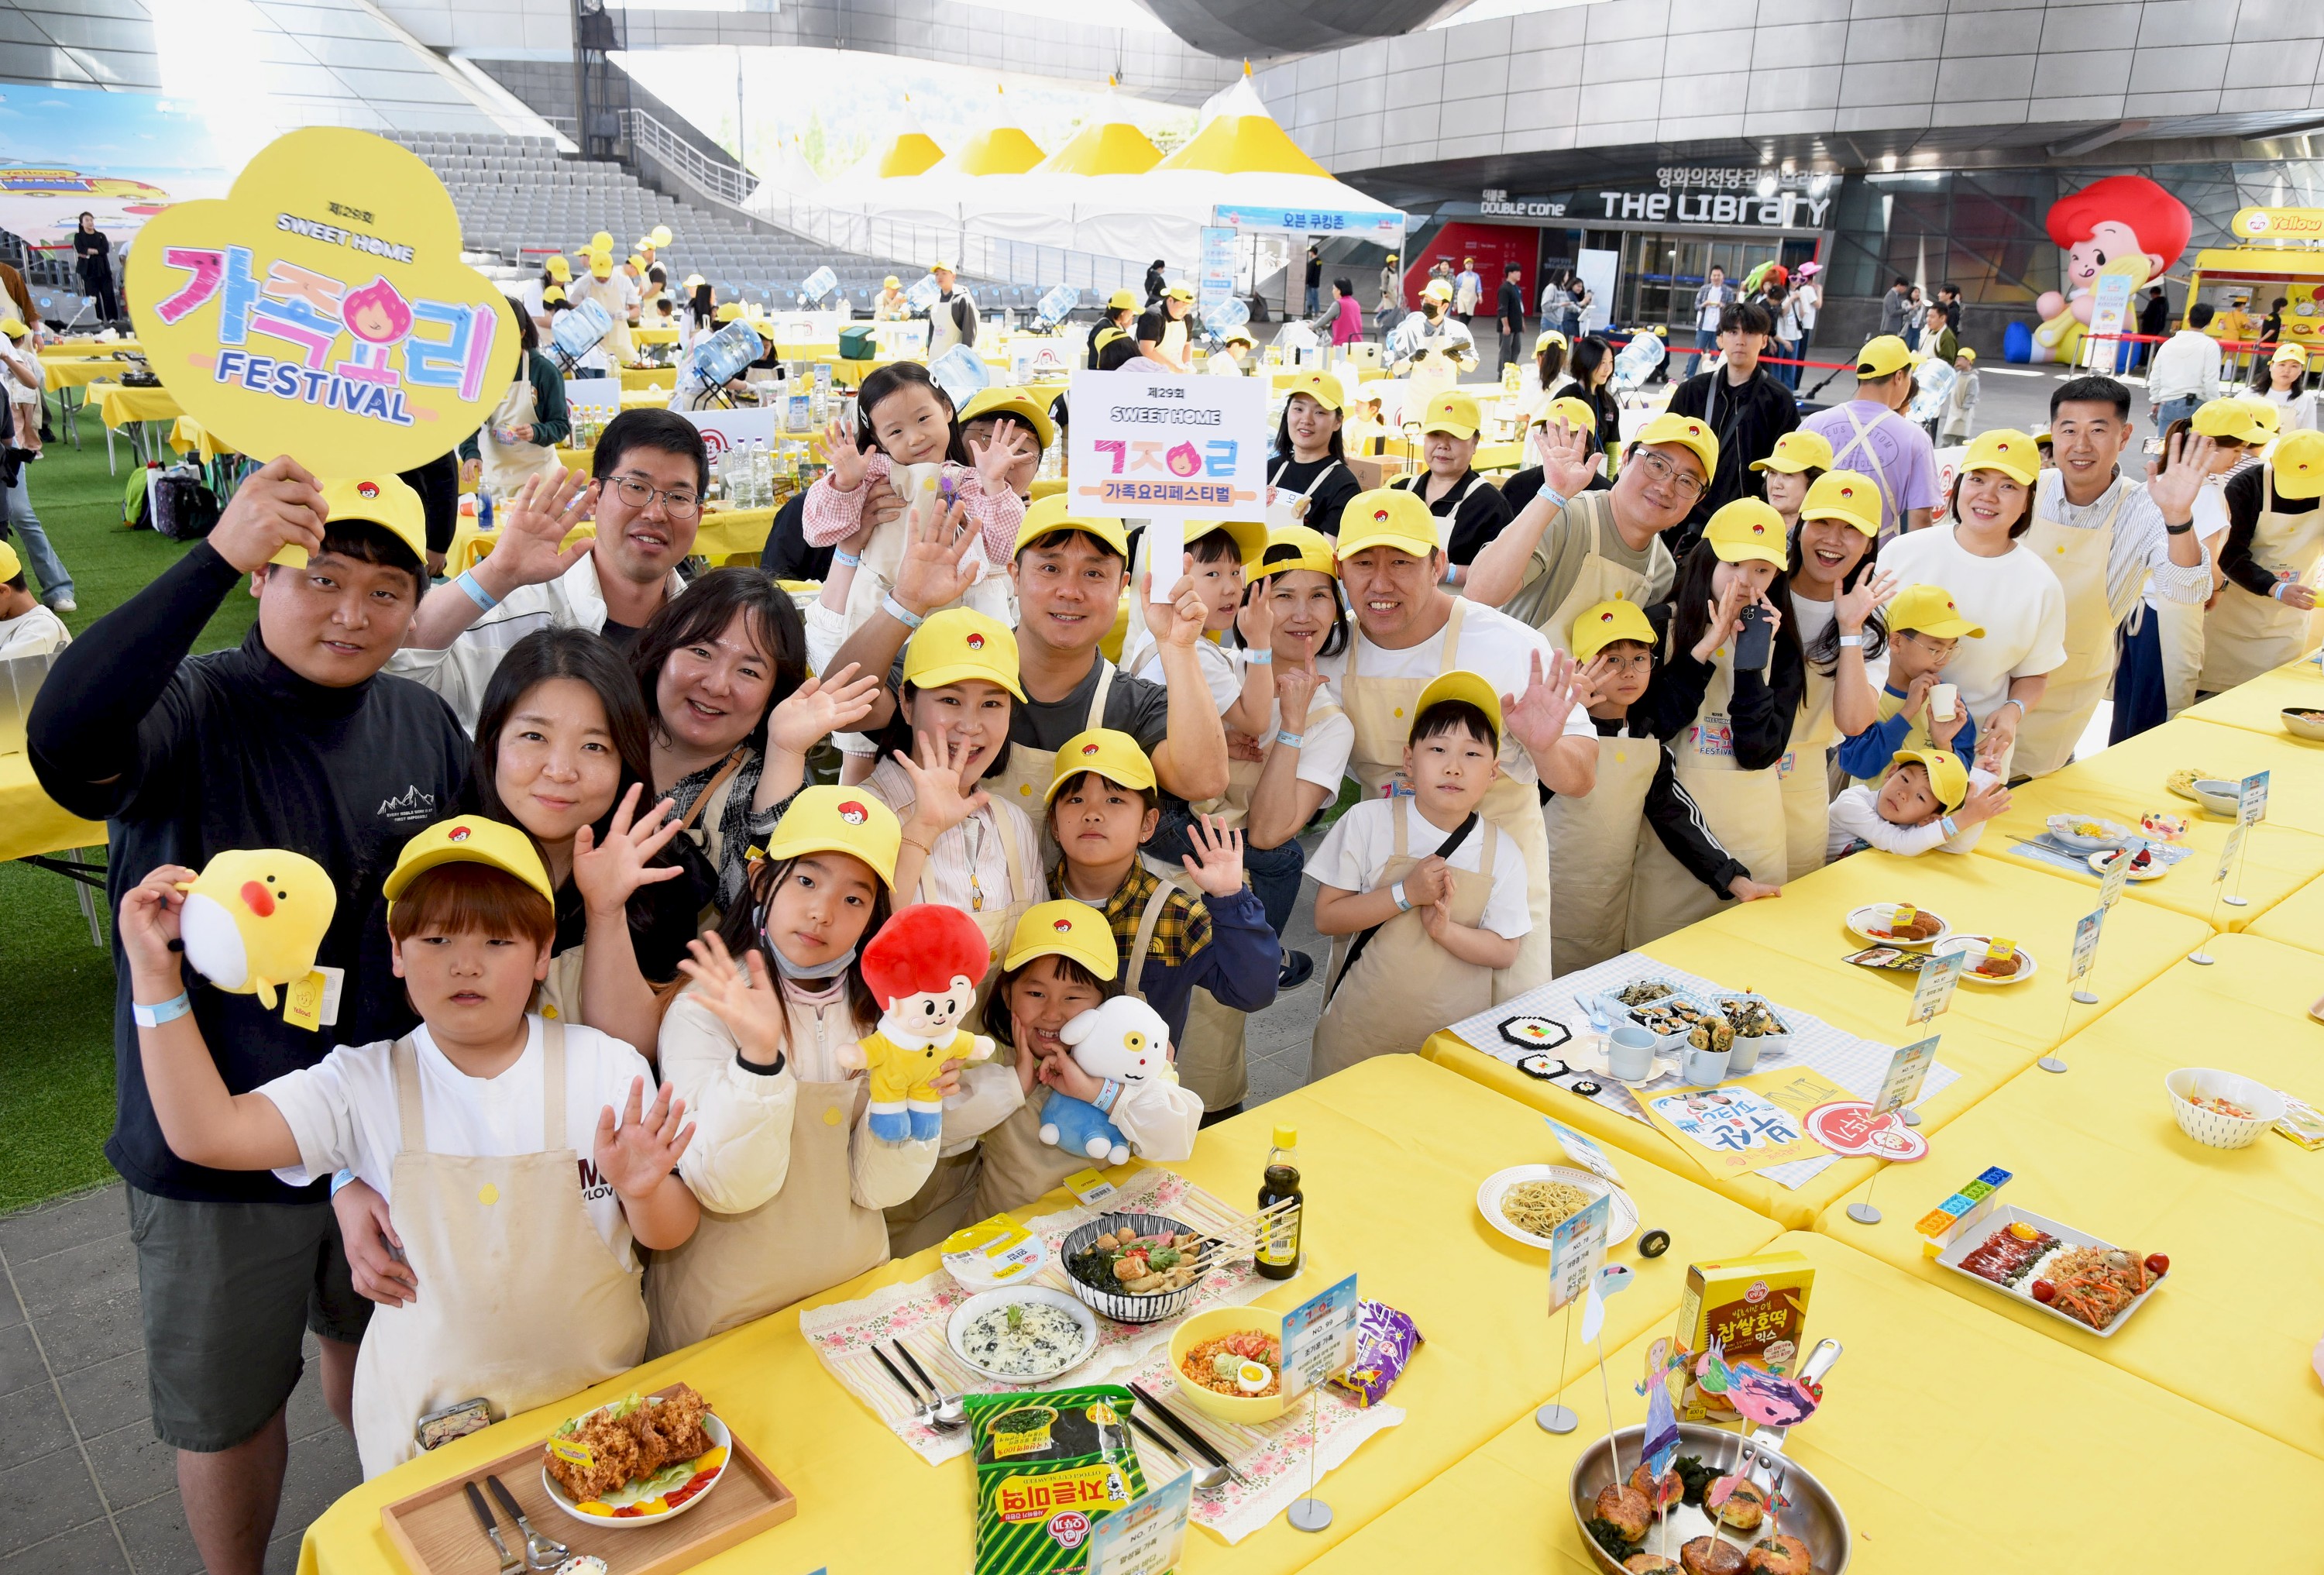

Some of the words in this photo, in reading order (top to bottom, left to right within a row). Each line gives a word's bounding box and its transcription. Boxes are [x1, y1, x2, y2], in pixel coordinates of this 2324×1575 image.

[1656, 167, 1742, 190] 영화의전당
[327, 200, 375, 225] 제29회
[1283, 213, 1307, 229] 오븐
[1310, 214, 1344, 230] 쿠킹존
[2271, 215, 2322, 232] Yellow
[276, 211, 352, 247] SWEET
[351, 233, 415, 265] HOME
[154, 242, 500, 403] 가족요리
[215, 348, 415, 427] FESTIVAL
[1147, 387, 1185, 400] 제29회
[1110, 406, 1170, 424] SWEET
[1171, 408, 1221, 426] HOME
[1105, 483, 1230, 504] 가족요리페스티벌
[294, 1006, 311, 1018] Yellows
[1709, 1116, 1800, 1150] 부산
[1312, 1324, 1325, 1336] NO.
[1325, 1319, 1333, 1328] 99
[1717, 1308, 1787, 1343] 찹쌀호떡
[1322, 1334, 1334, 1345] 가족
[1755, 1329, 1778, 1344] 믹스
[1023, 1475, 1057, 1484] SEAWEED
[1073, 1470, 1101, 1479] OTTOGI
[1002, 1479, 1105, 1511] 자른미역
[1054, 1518, 1083, 1529] 오뚜기
[1130, 1531, 1146, 1542] NO.
[1148, 1522, 1157, 1532] 77
